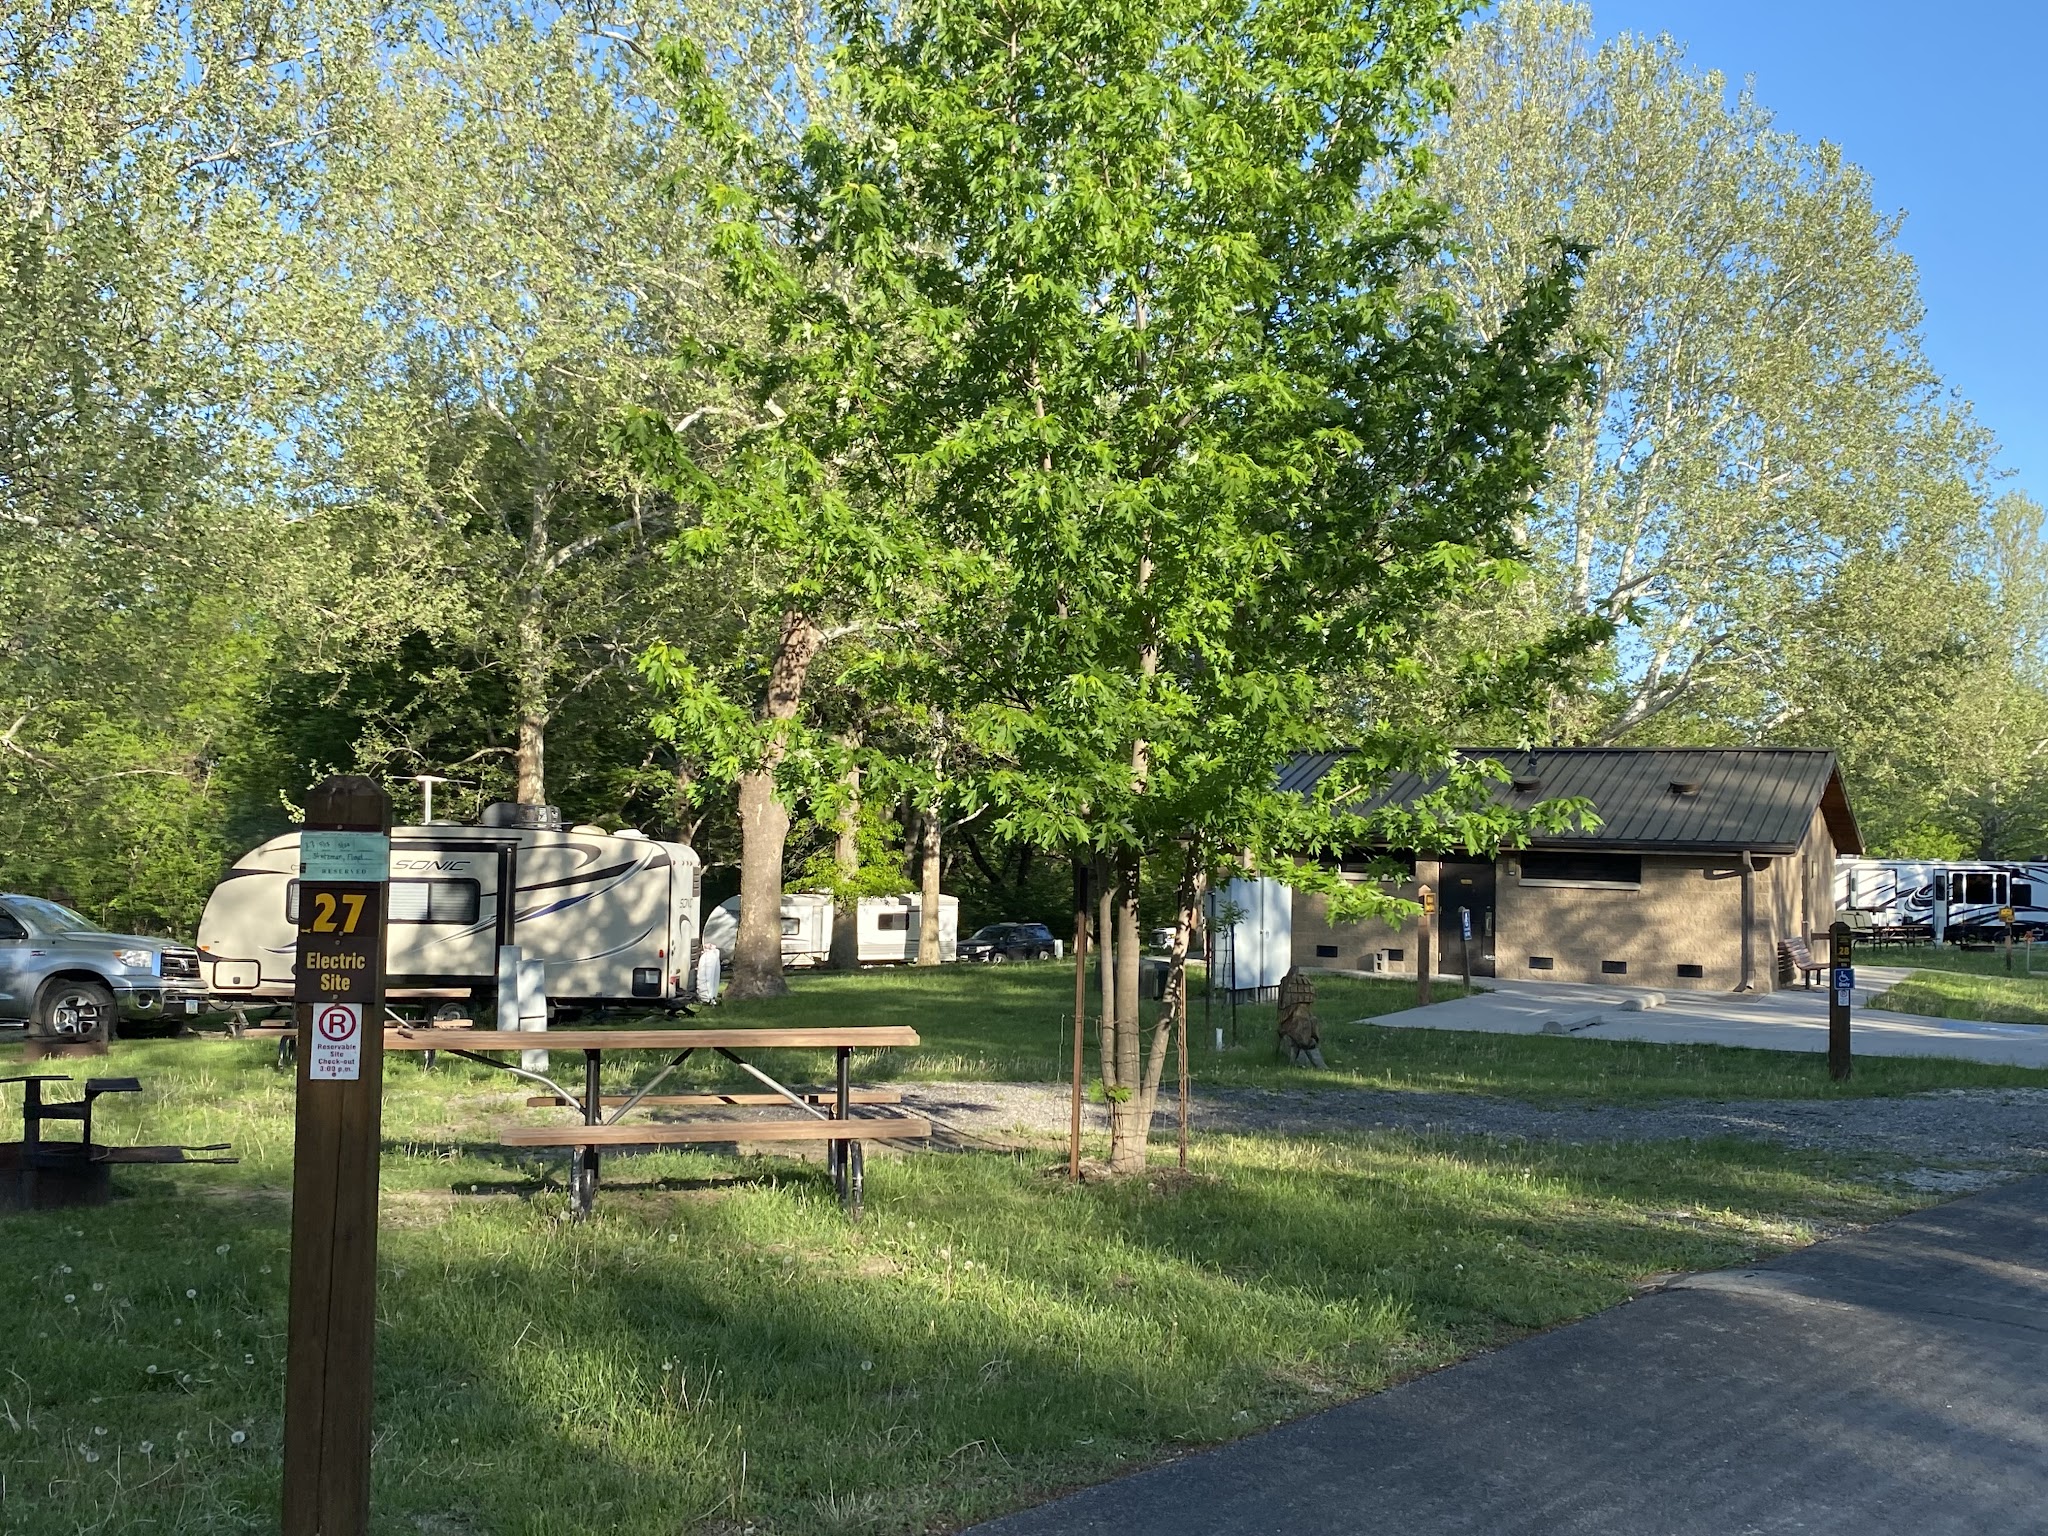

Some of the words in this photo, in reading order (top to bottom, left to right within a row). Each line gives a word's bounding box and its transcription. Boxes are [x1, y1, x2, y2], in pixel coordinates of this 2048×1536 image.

[392, 859, 471, 871] SONIC
[313, 892, 367, 933] 27
[1839, 946, 1850, 955] 28
[306, 952, 366, 970] Electric
[320, 973, 351, 991] Site
[329, 1014, 346, 1033] R
